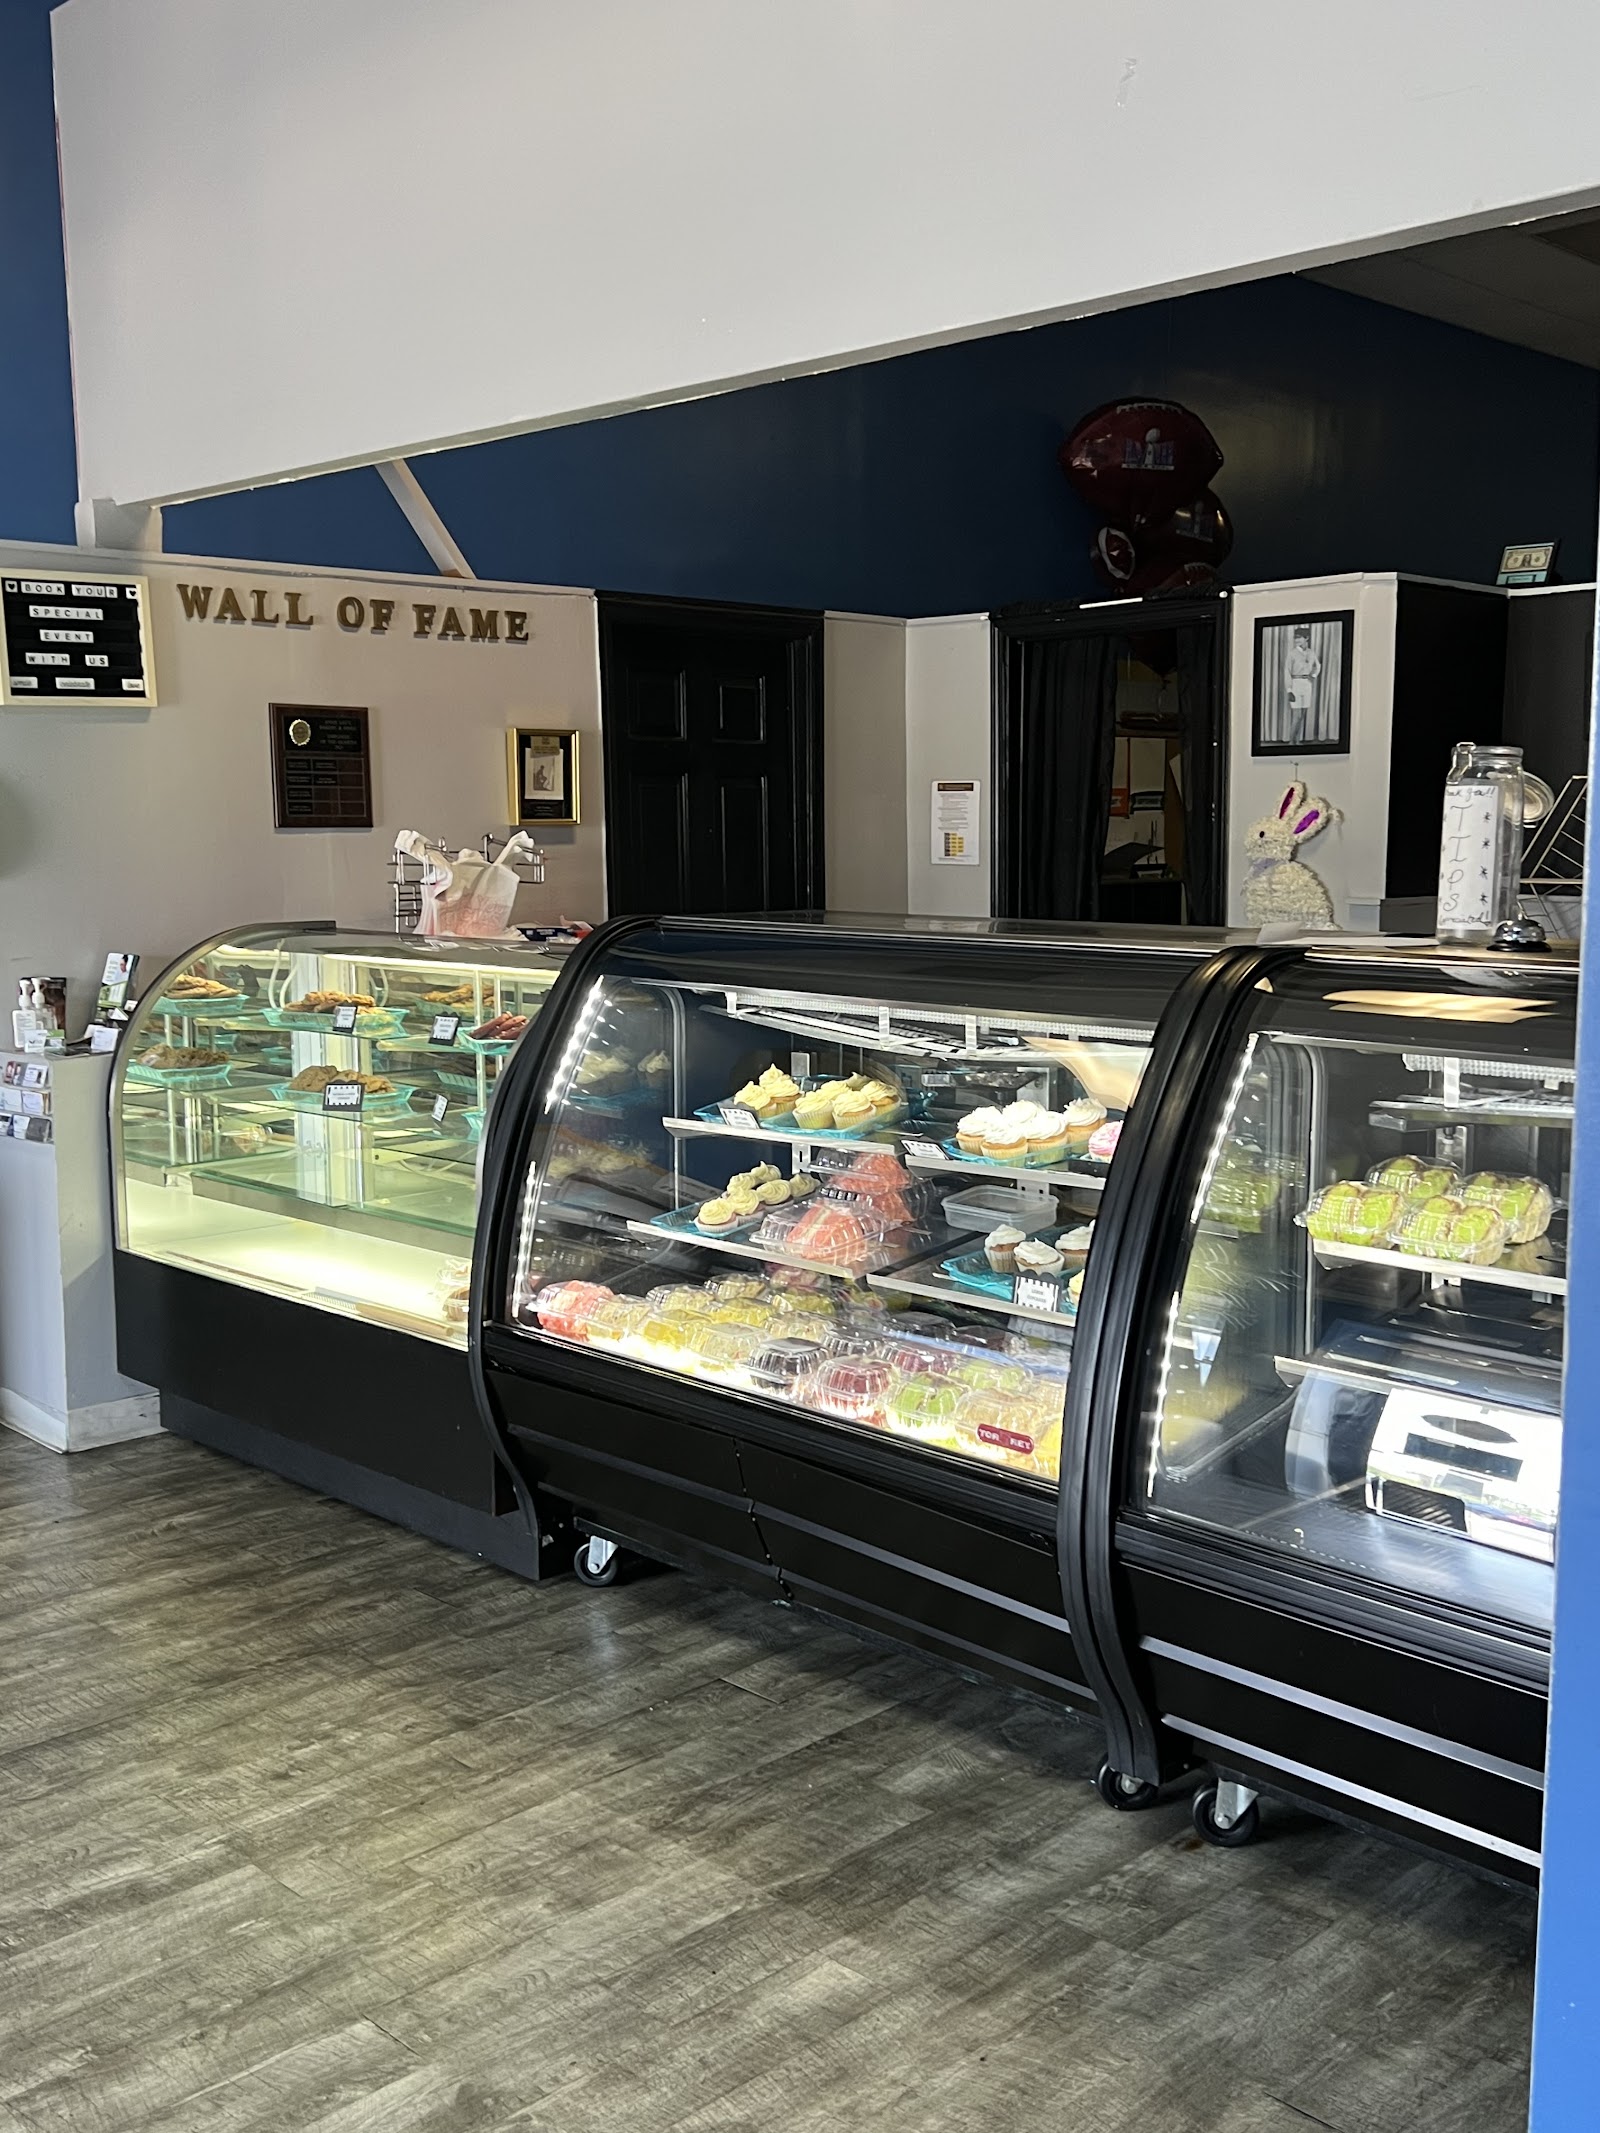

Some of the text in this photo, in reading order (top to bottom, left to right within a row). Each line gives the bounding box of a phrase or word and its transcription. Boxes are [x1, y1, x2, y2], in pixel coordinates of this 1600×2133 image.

[25, 584, 115, 596] BOOK YOUR
[33, 607, 101, 619] SPECIAL
[176, 583, 530, 642] WALL OF FAME
[44, 632, 91, 641] EVENT
[28, 655, 106, 665] WITH US
